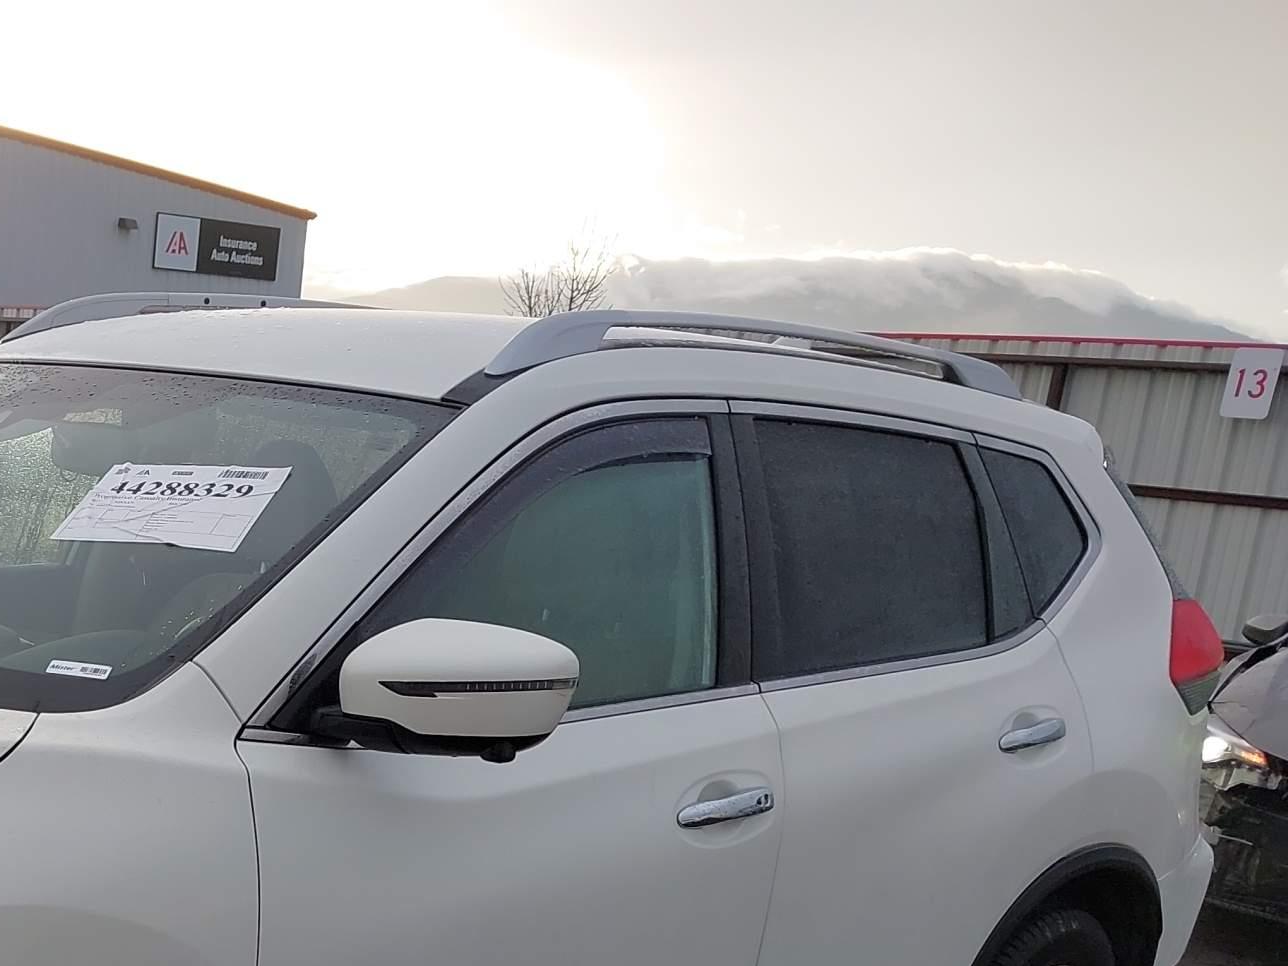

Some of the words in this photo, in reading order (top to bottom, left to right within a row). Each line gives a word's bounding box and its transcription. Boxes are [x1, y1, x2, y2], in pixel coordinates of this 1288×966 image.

[219, 235, 258, 251] Insurance
[210, 249, 229, 261] Auto
[230, 251, 263, 266] Auctions
[1234, 368, 1268, 399] 13
[110, 481, 254, 498] 44288329
